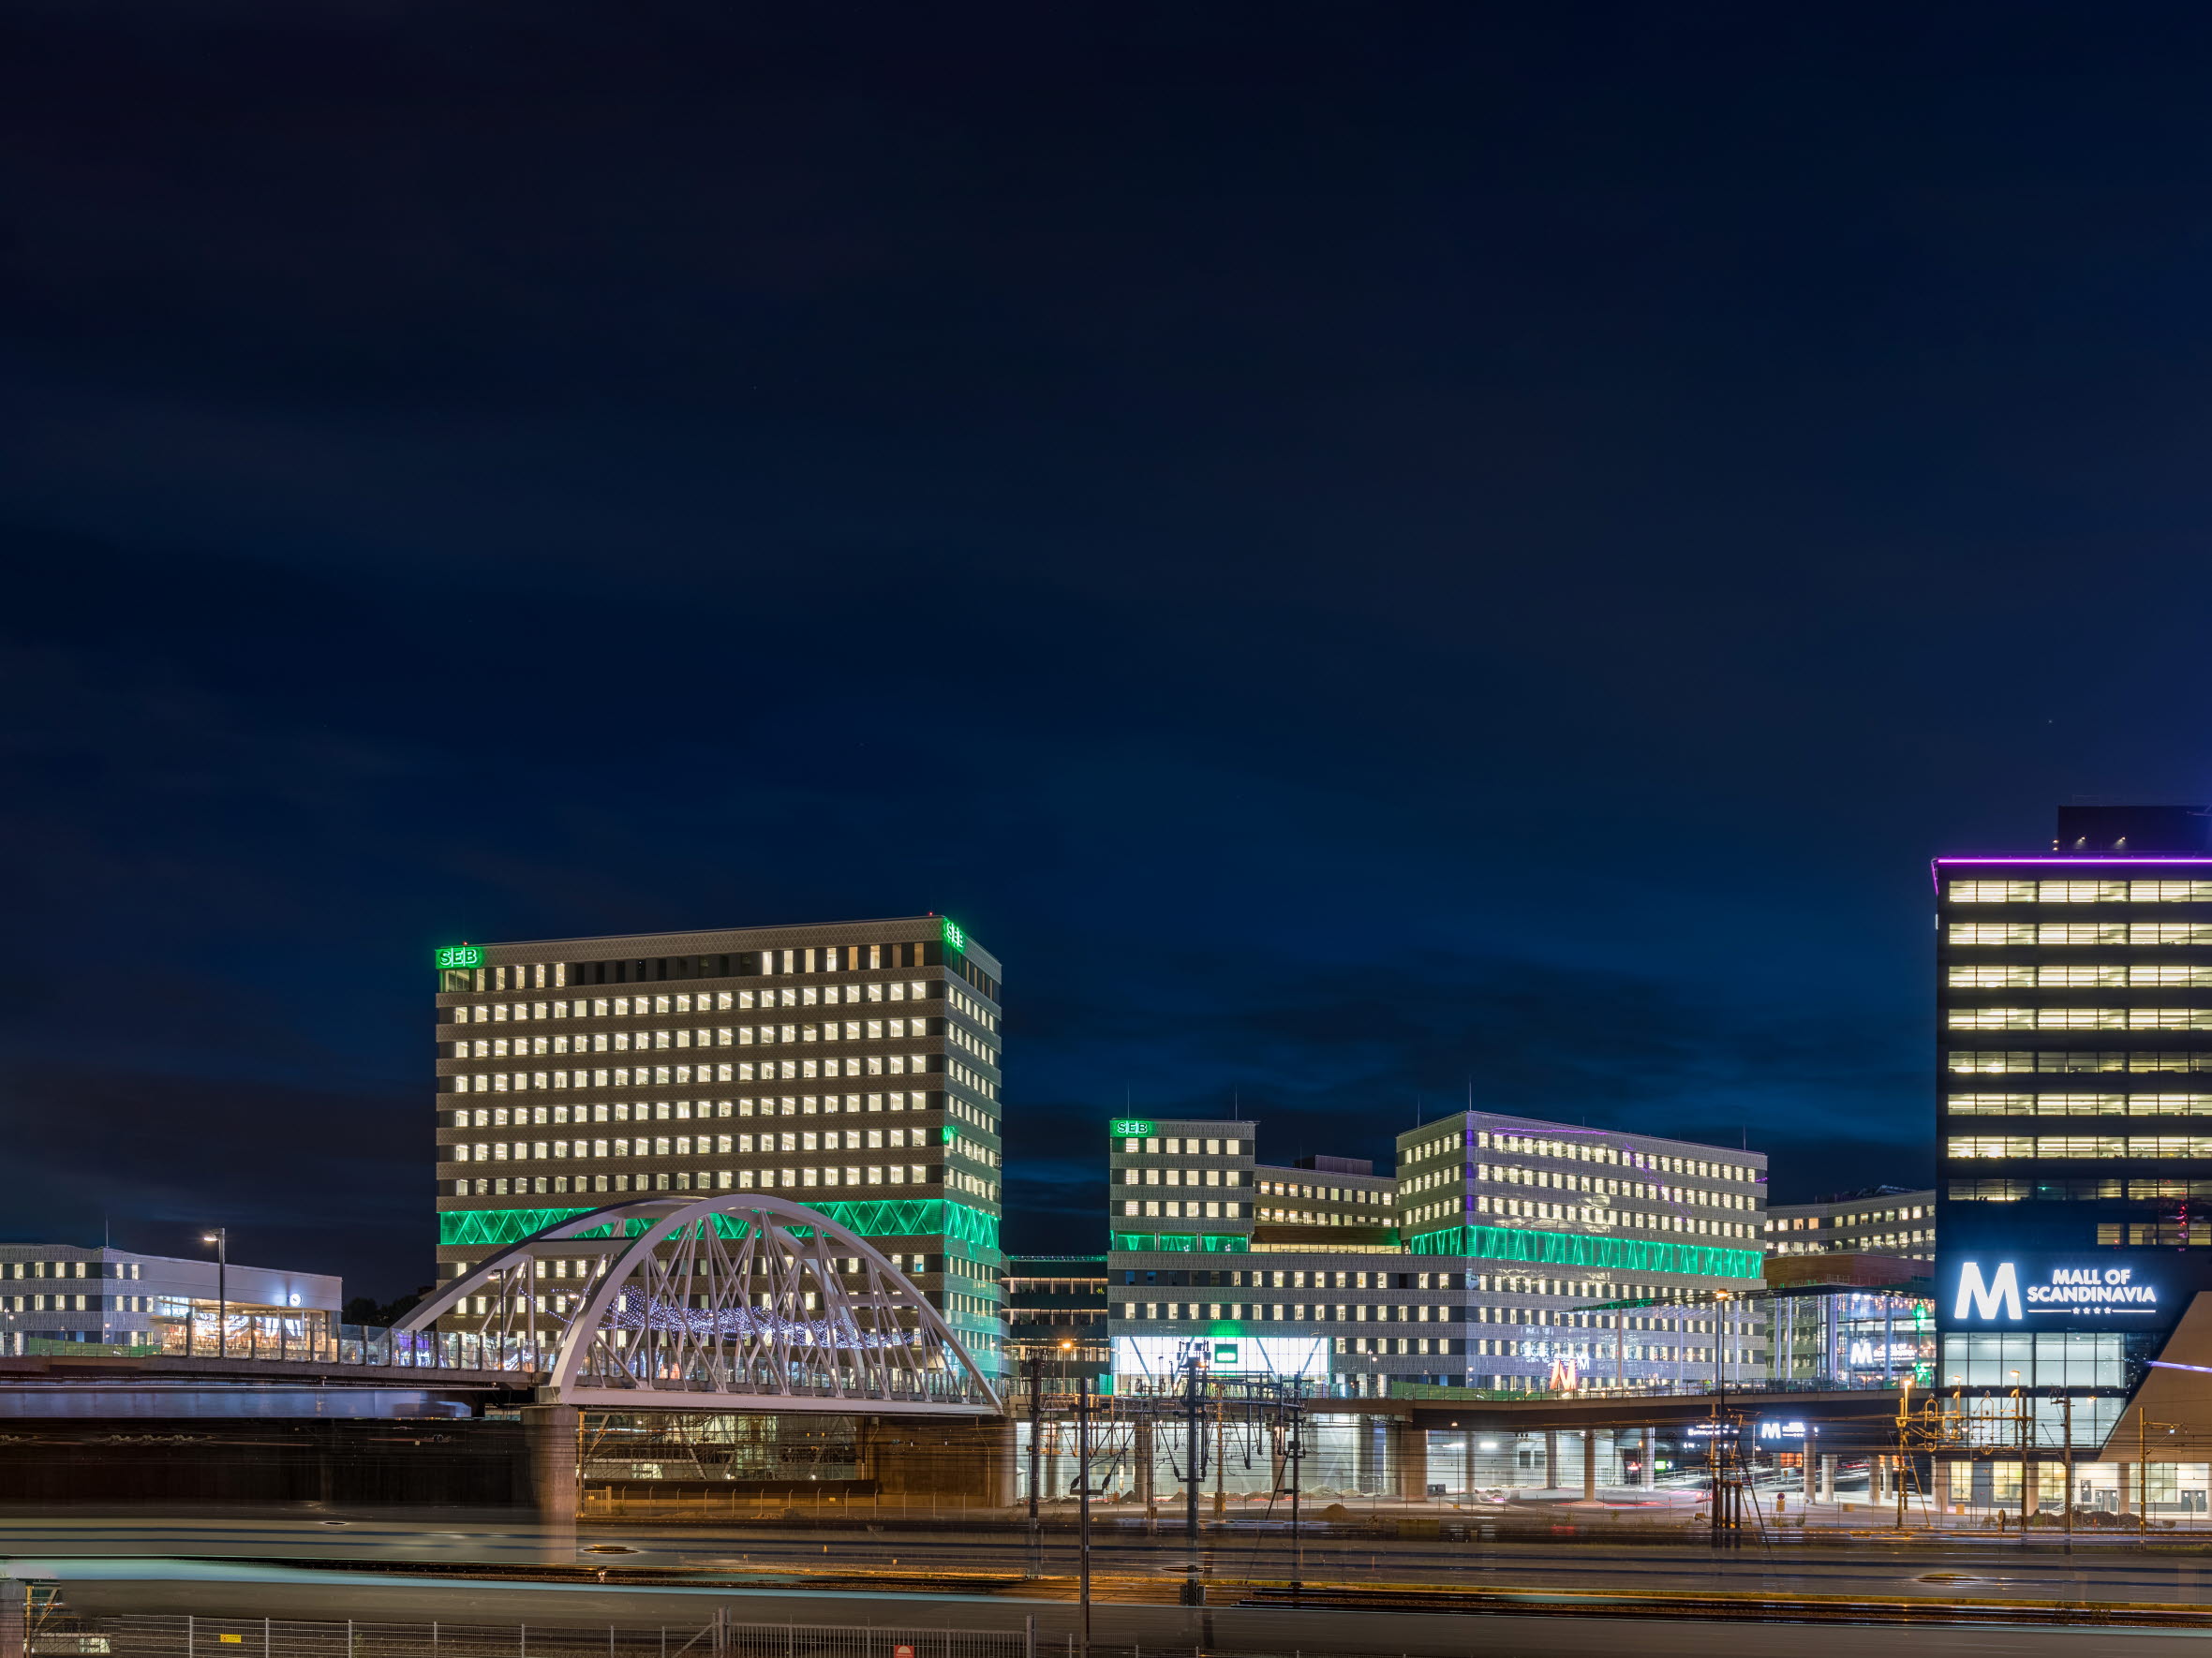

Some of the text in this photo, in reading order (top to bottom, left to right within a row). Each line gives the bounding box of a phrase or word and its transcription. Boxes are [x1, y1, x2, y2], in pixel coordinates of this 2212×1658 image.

[439, 948, 478, 966] SEB
[1117, 1121, 1148, 1134] SEB
[2052, 1269, 2131, 1285] MALL OF
[1953, 1262, 2023, 1320] M
[2026, 1286, 2157, 1302] SCANDINAVIA
[1849, 1342, 1873, 1364] M
[1761, 1423, 1781, 1439] M
